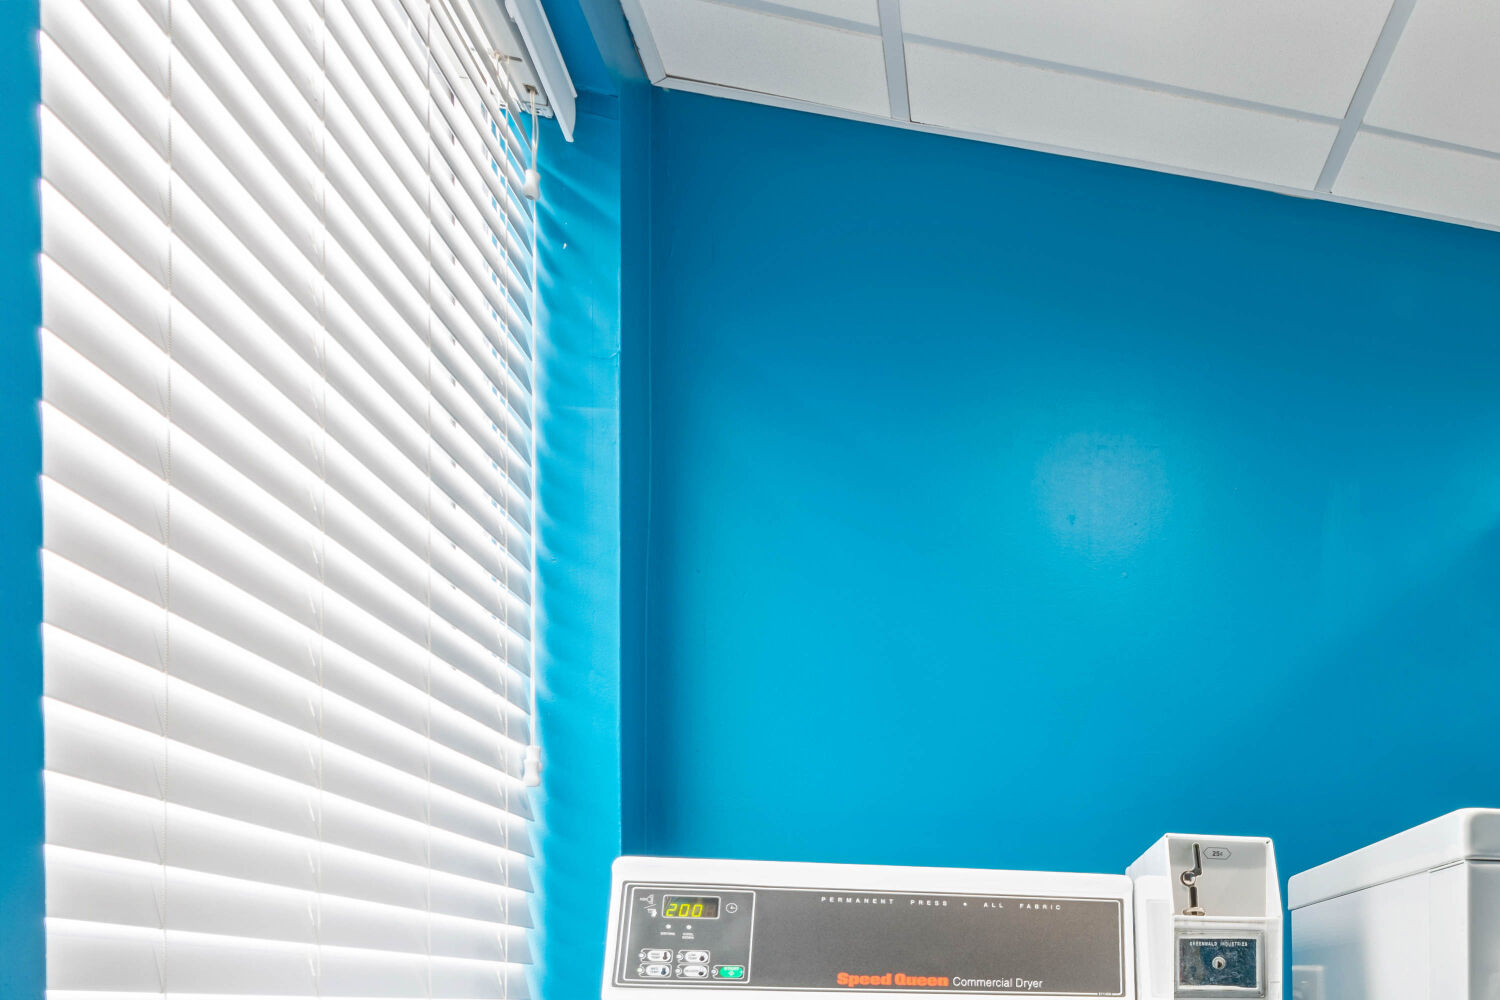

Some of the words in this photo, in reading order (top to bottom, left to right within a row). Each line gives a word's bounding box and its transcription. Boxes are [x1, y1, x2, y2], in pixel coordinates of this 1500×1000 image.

[821, 896, 894, 904] PERMANENT
[910, 899, 948, 907] PRESS
[665, 903, 704, 918] 200
[836, 972, 893, 988] Speed
[894, 972, 950, 986] Queen
[952, 976, 1013, 988] Commercial
[1016, 978, 1043, 990] Dryer
